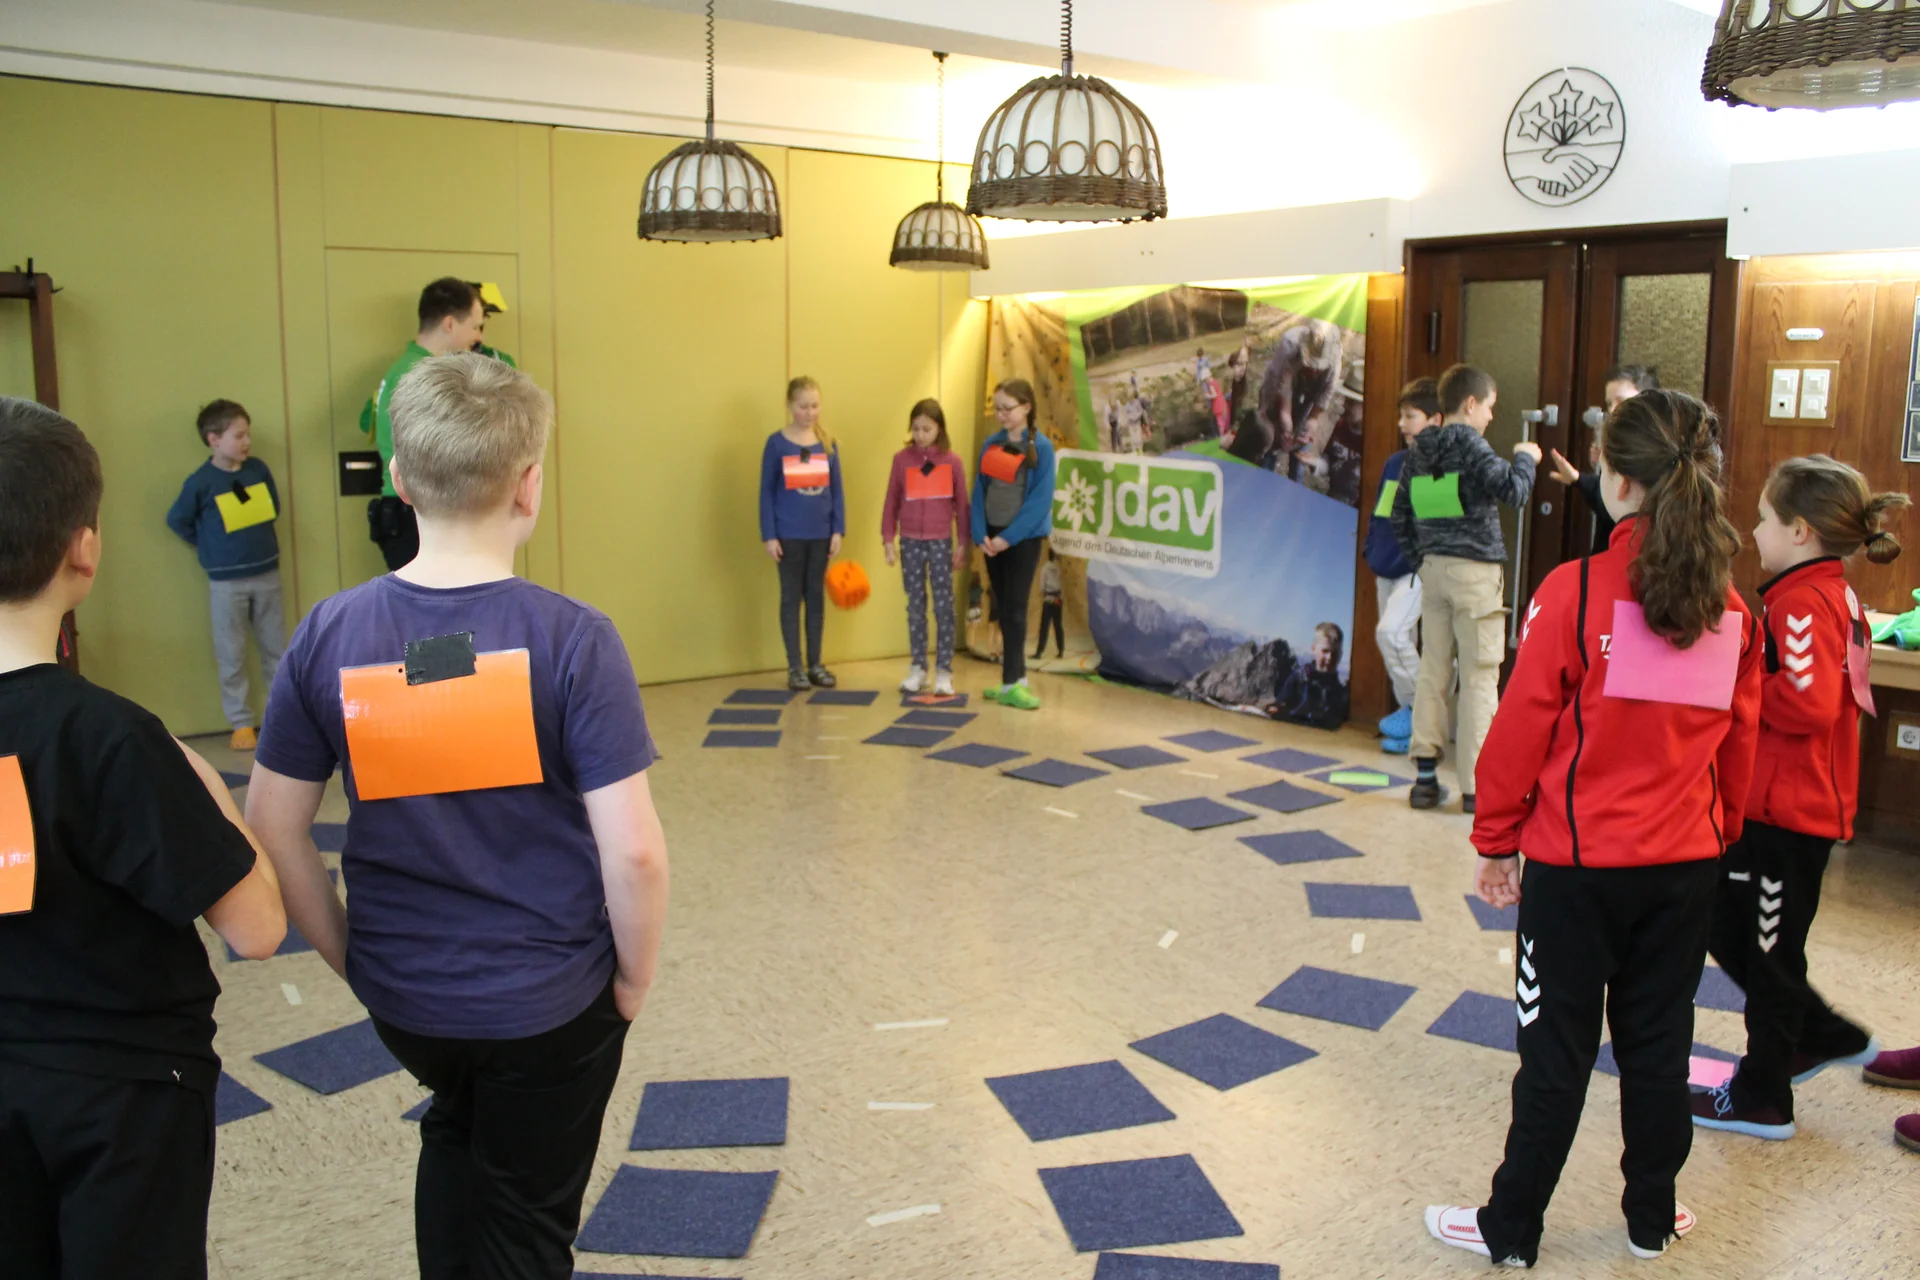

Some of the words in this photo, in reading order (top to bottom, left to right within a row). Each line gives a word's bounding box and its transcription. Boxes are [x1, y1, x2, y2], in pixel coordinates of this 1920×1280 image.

[1098, 461, 1217, 537] jdav
[1084, 541, 1101, 552] des
[1105, 542, 1152, 559] Deutschen
[1154, 550, 1213, 570] Alpenvereins
